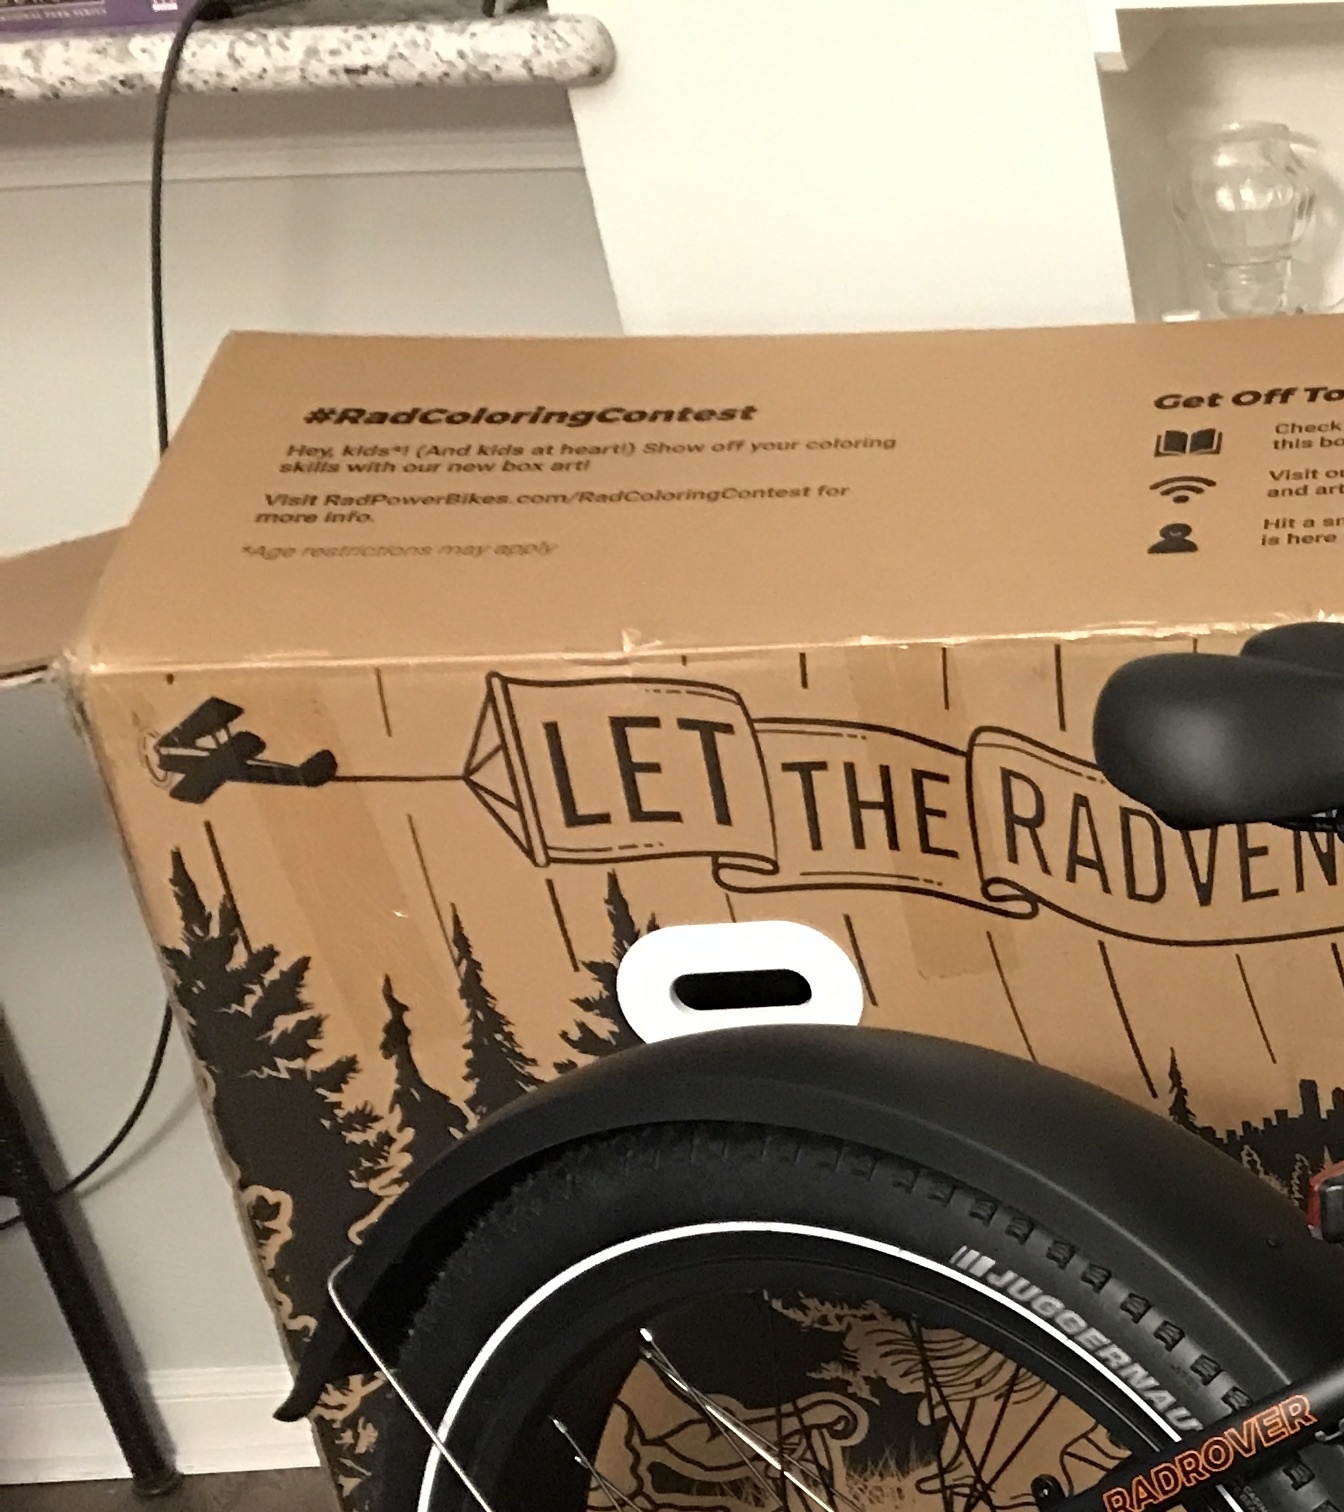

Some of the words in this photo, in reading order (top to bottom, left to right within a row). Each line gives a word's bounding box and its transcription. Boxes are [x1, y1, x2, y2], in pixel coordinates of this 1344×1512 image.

[1153, 392, 1223, 410] Get
[1231, 387, 1298, 406] Off
[303, 405, 757, 428] #RadColoringContest
[1275, 420, 1342, 435] Check
[286, 444, 334, 460] Hey,
[415, 443, 471, 460] (And
[476, 443, 524, 457] kids
[530, 443, 554, 457] at
[642, 441, 705, 455] Show
[711, 439, 745, 452] off
[750, 440, 800, 454] your
[805, 436, 897, 451] coloring
[1273, 437, 1313, 450] this
[279, 459, 340, 473] skills
[347, 459, 396, 473] with
[402, 461, 443, 473] our
[446, 461, 497, 473] new
[501, 459, 544, 473] box
[1269, 467, 1319, 482] Visit
[265, 493, 318, 507] Visit
[817, 484, 850, 498] for
[1267, 484, 1308, 498] and
[255, 511, 318, 524] more
[324, 510, 375, 524] info.
[1263, 517, 1297, 531] Hit
[1303, 516, 1316, 528] a
[1261, 532, 1280, 546] is
[1287, 530, 1338, 545] here
[303, 543, 434, 558] restrictions
[543, 715, 735, 830] LET
[781, 760, 960, 860] THE
[985, 1267, 1203, 1433] JUGGERNAU
